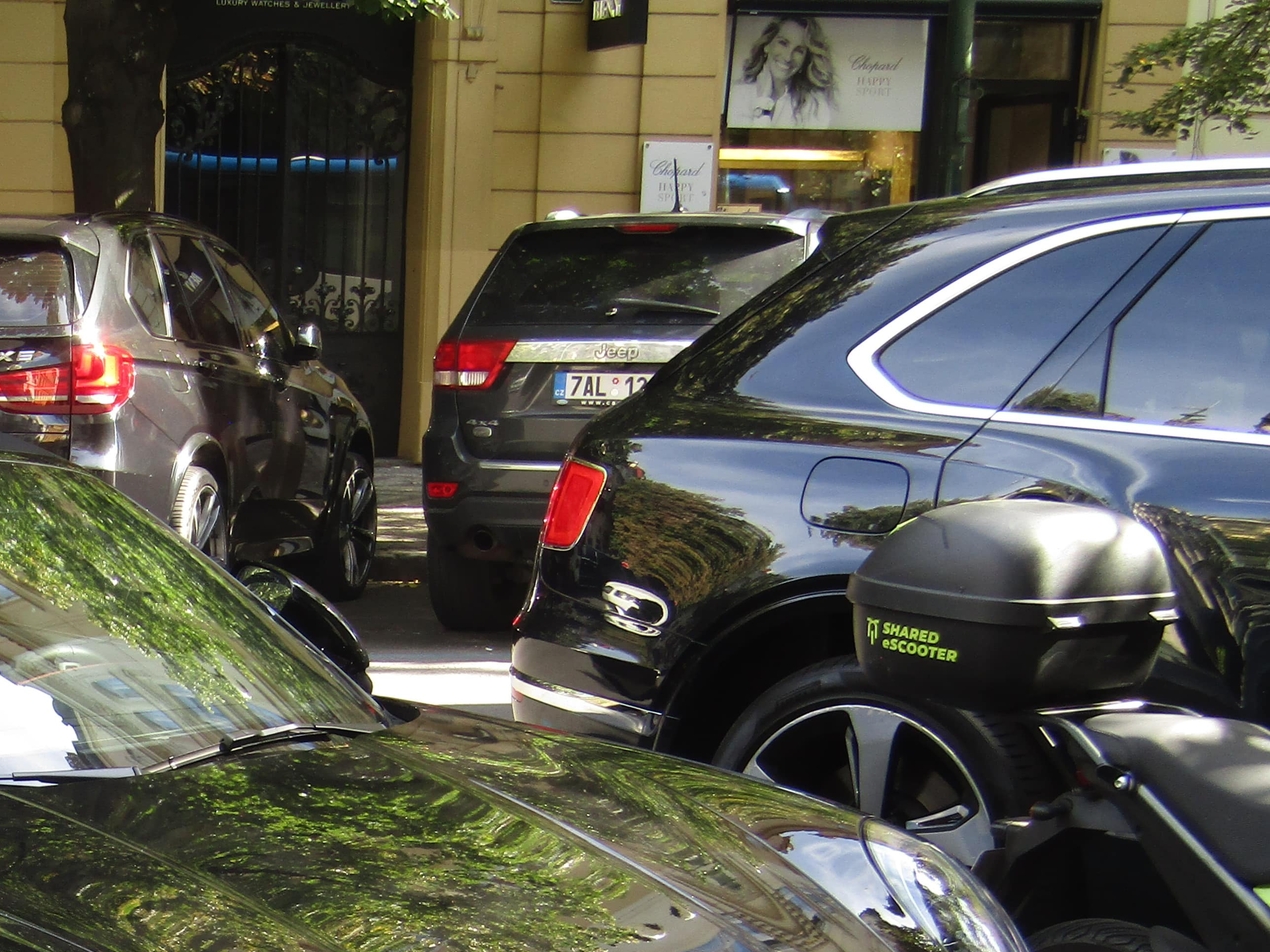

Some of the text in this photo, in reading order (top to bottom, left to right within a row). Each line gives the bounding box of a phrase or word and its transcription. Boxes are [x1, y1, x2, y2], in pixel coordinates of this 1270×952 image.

[251, 0, 291, 8] WATCHES
[302, 2, 351, 10] JEWELLERY
[848, 54, 904, 74] Chopard
[857, 76, 892, 86] HAPPY
[856, 87, 892, 97] SPORT
[649, 159, 706, 179] Chopard
[594, 344, 640, 361] Jeep
[570, 375, 607, 397] 7AL
[882, 622, 939, 644] SHARED
[882, 638, 958, 662] eSCOOTER
